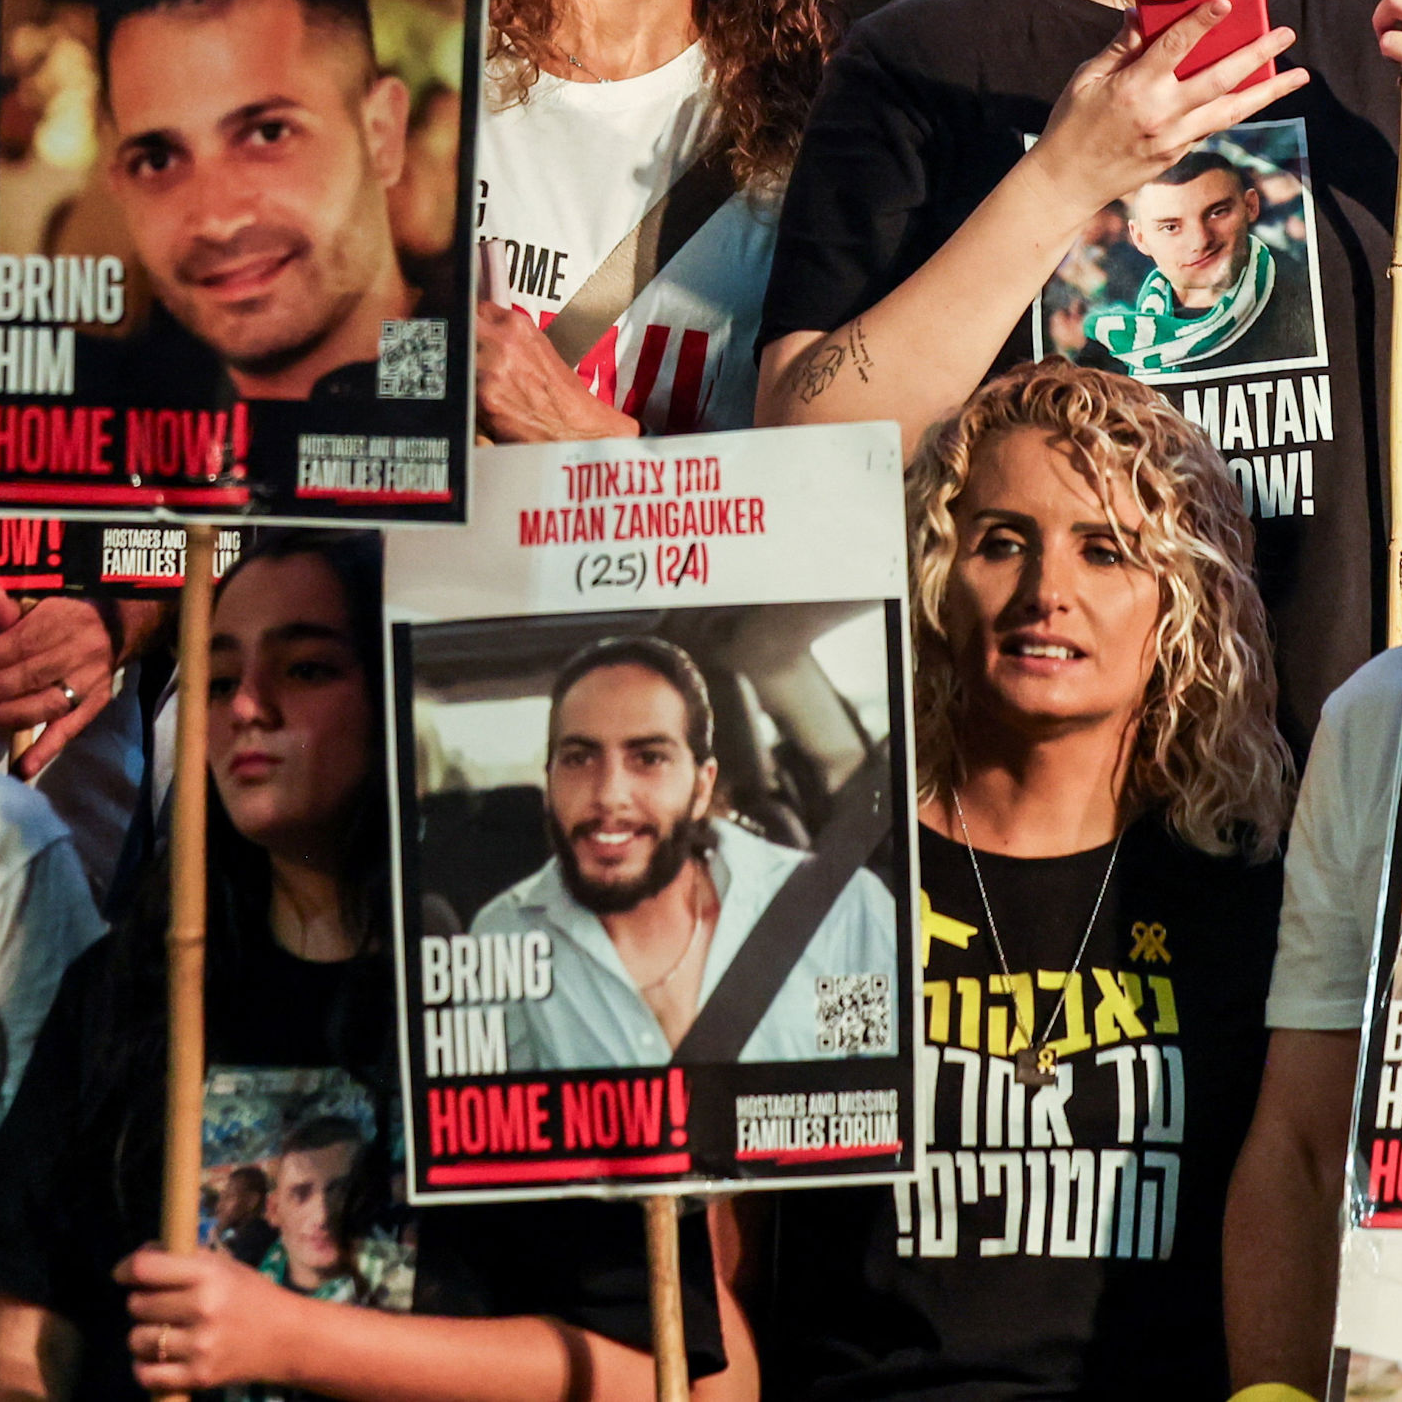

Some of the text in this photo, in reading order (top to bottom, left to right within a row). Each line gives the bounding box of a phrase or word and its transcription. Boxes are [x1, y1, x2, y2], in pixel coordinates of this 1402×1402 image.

[126, 402, 250, 479] NOW!
[1183, 375, 1334, 451] MATAN
[562, 457, 721, 504] מתן צנגאוקר
[103, 528, 161, 549] HOSTAGES
[519, 498, 766, 547] MATAN ZANGAUKER
[102, 548, 177, 577] FAMILIES
[575, 551, 647, 595] (25)
[422, 931, 552, 1006] BRING
[423, 1006, 508, 1077] HIM
[428, 1084, 552, 1156] HOME
[563, 1068, 689, 1148] NOW!
[1096, 1044, 1186, 1144] עד
[737, 1113, 898, 1151] FAMILIES FORUM
[898, 1149, 1181, 1260] החטופים!
